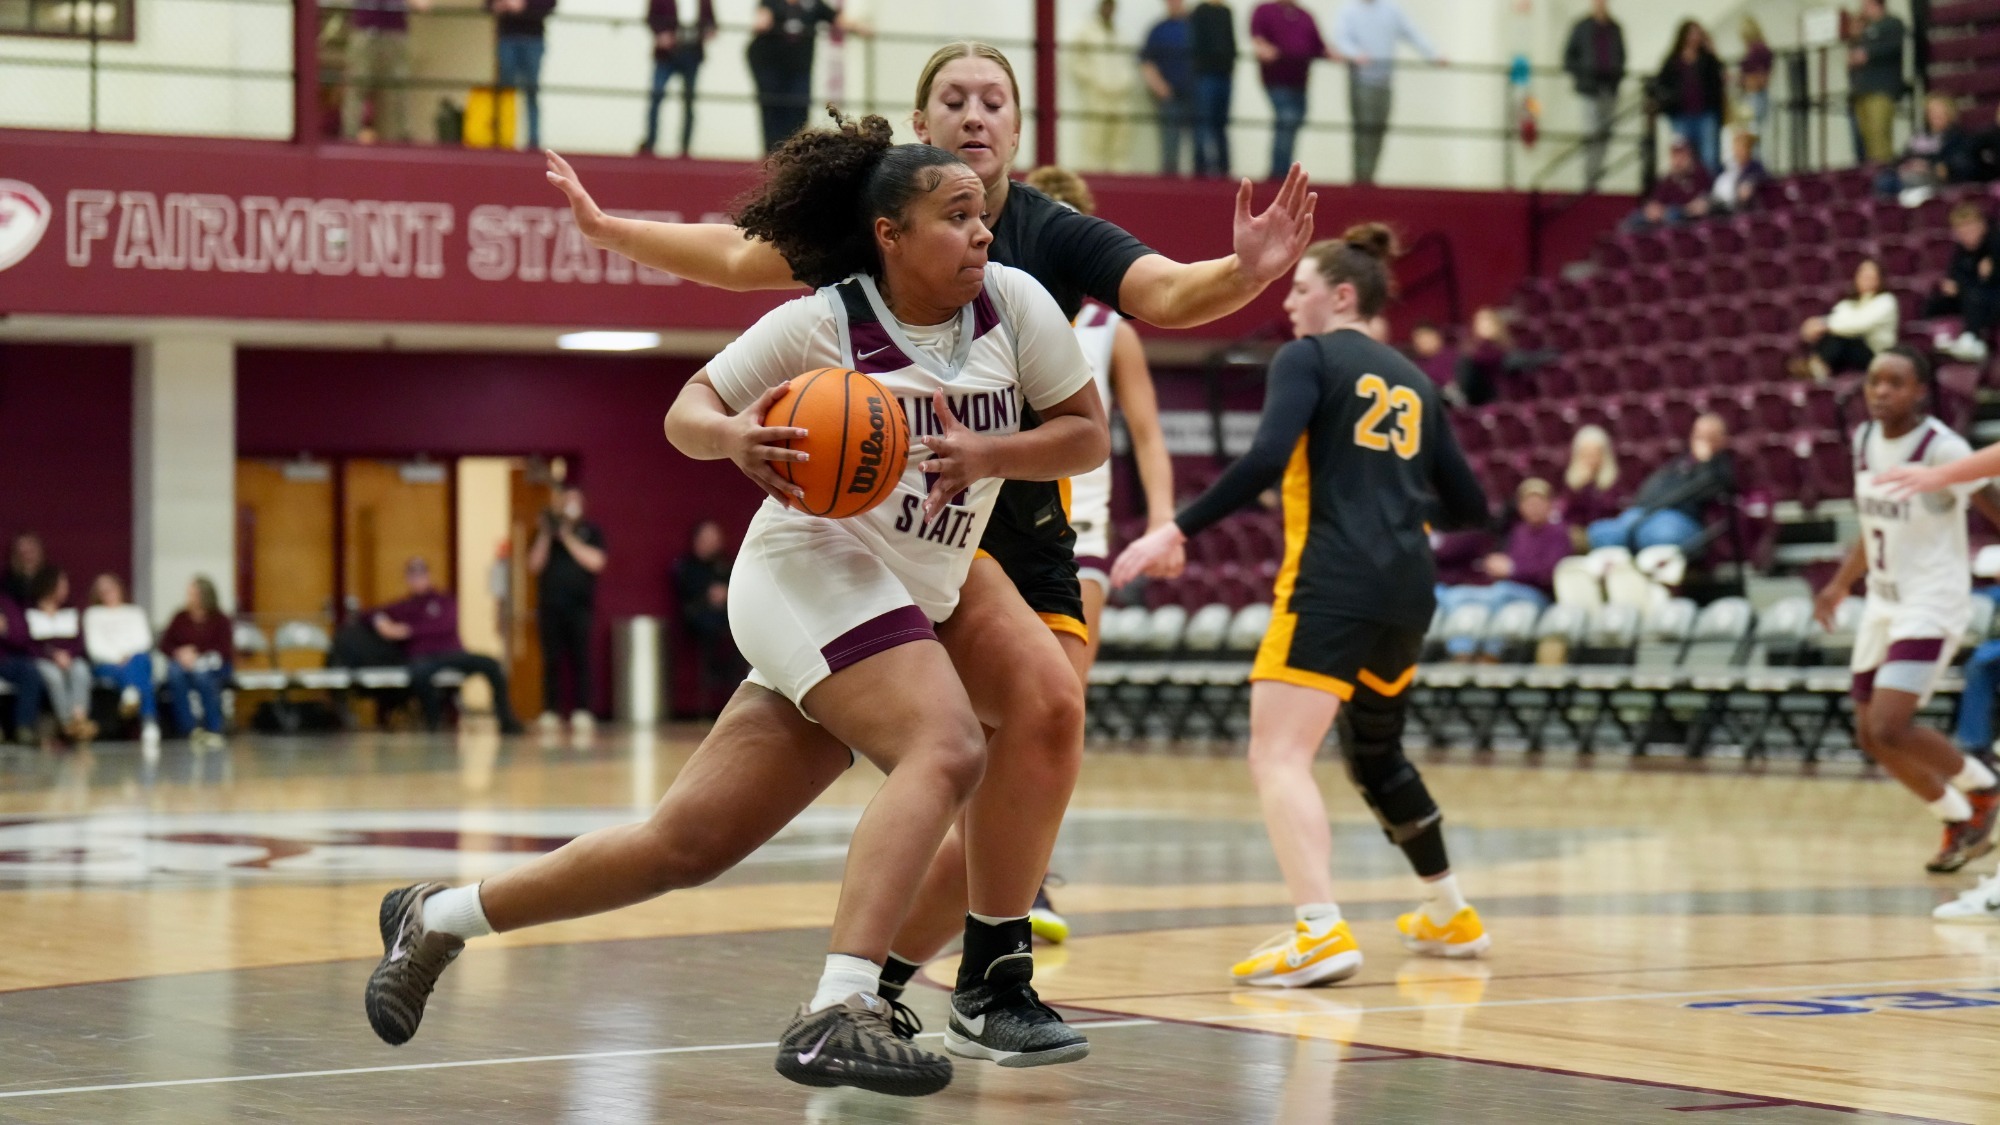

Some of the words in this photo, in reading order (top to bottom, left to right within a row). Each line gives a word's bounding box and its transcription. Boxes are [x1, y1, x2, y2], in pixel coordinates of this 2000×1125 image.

[66, 188, 454, 279] FAIRMONT
[847, 396, 885, 494] Wilson
[897, 384, 1017, 436] IRMONT
[1354, 373, 1422, 460] 23
